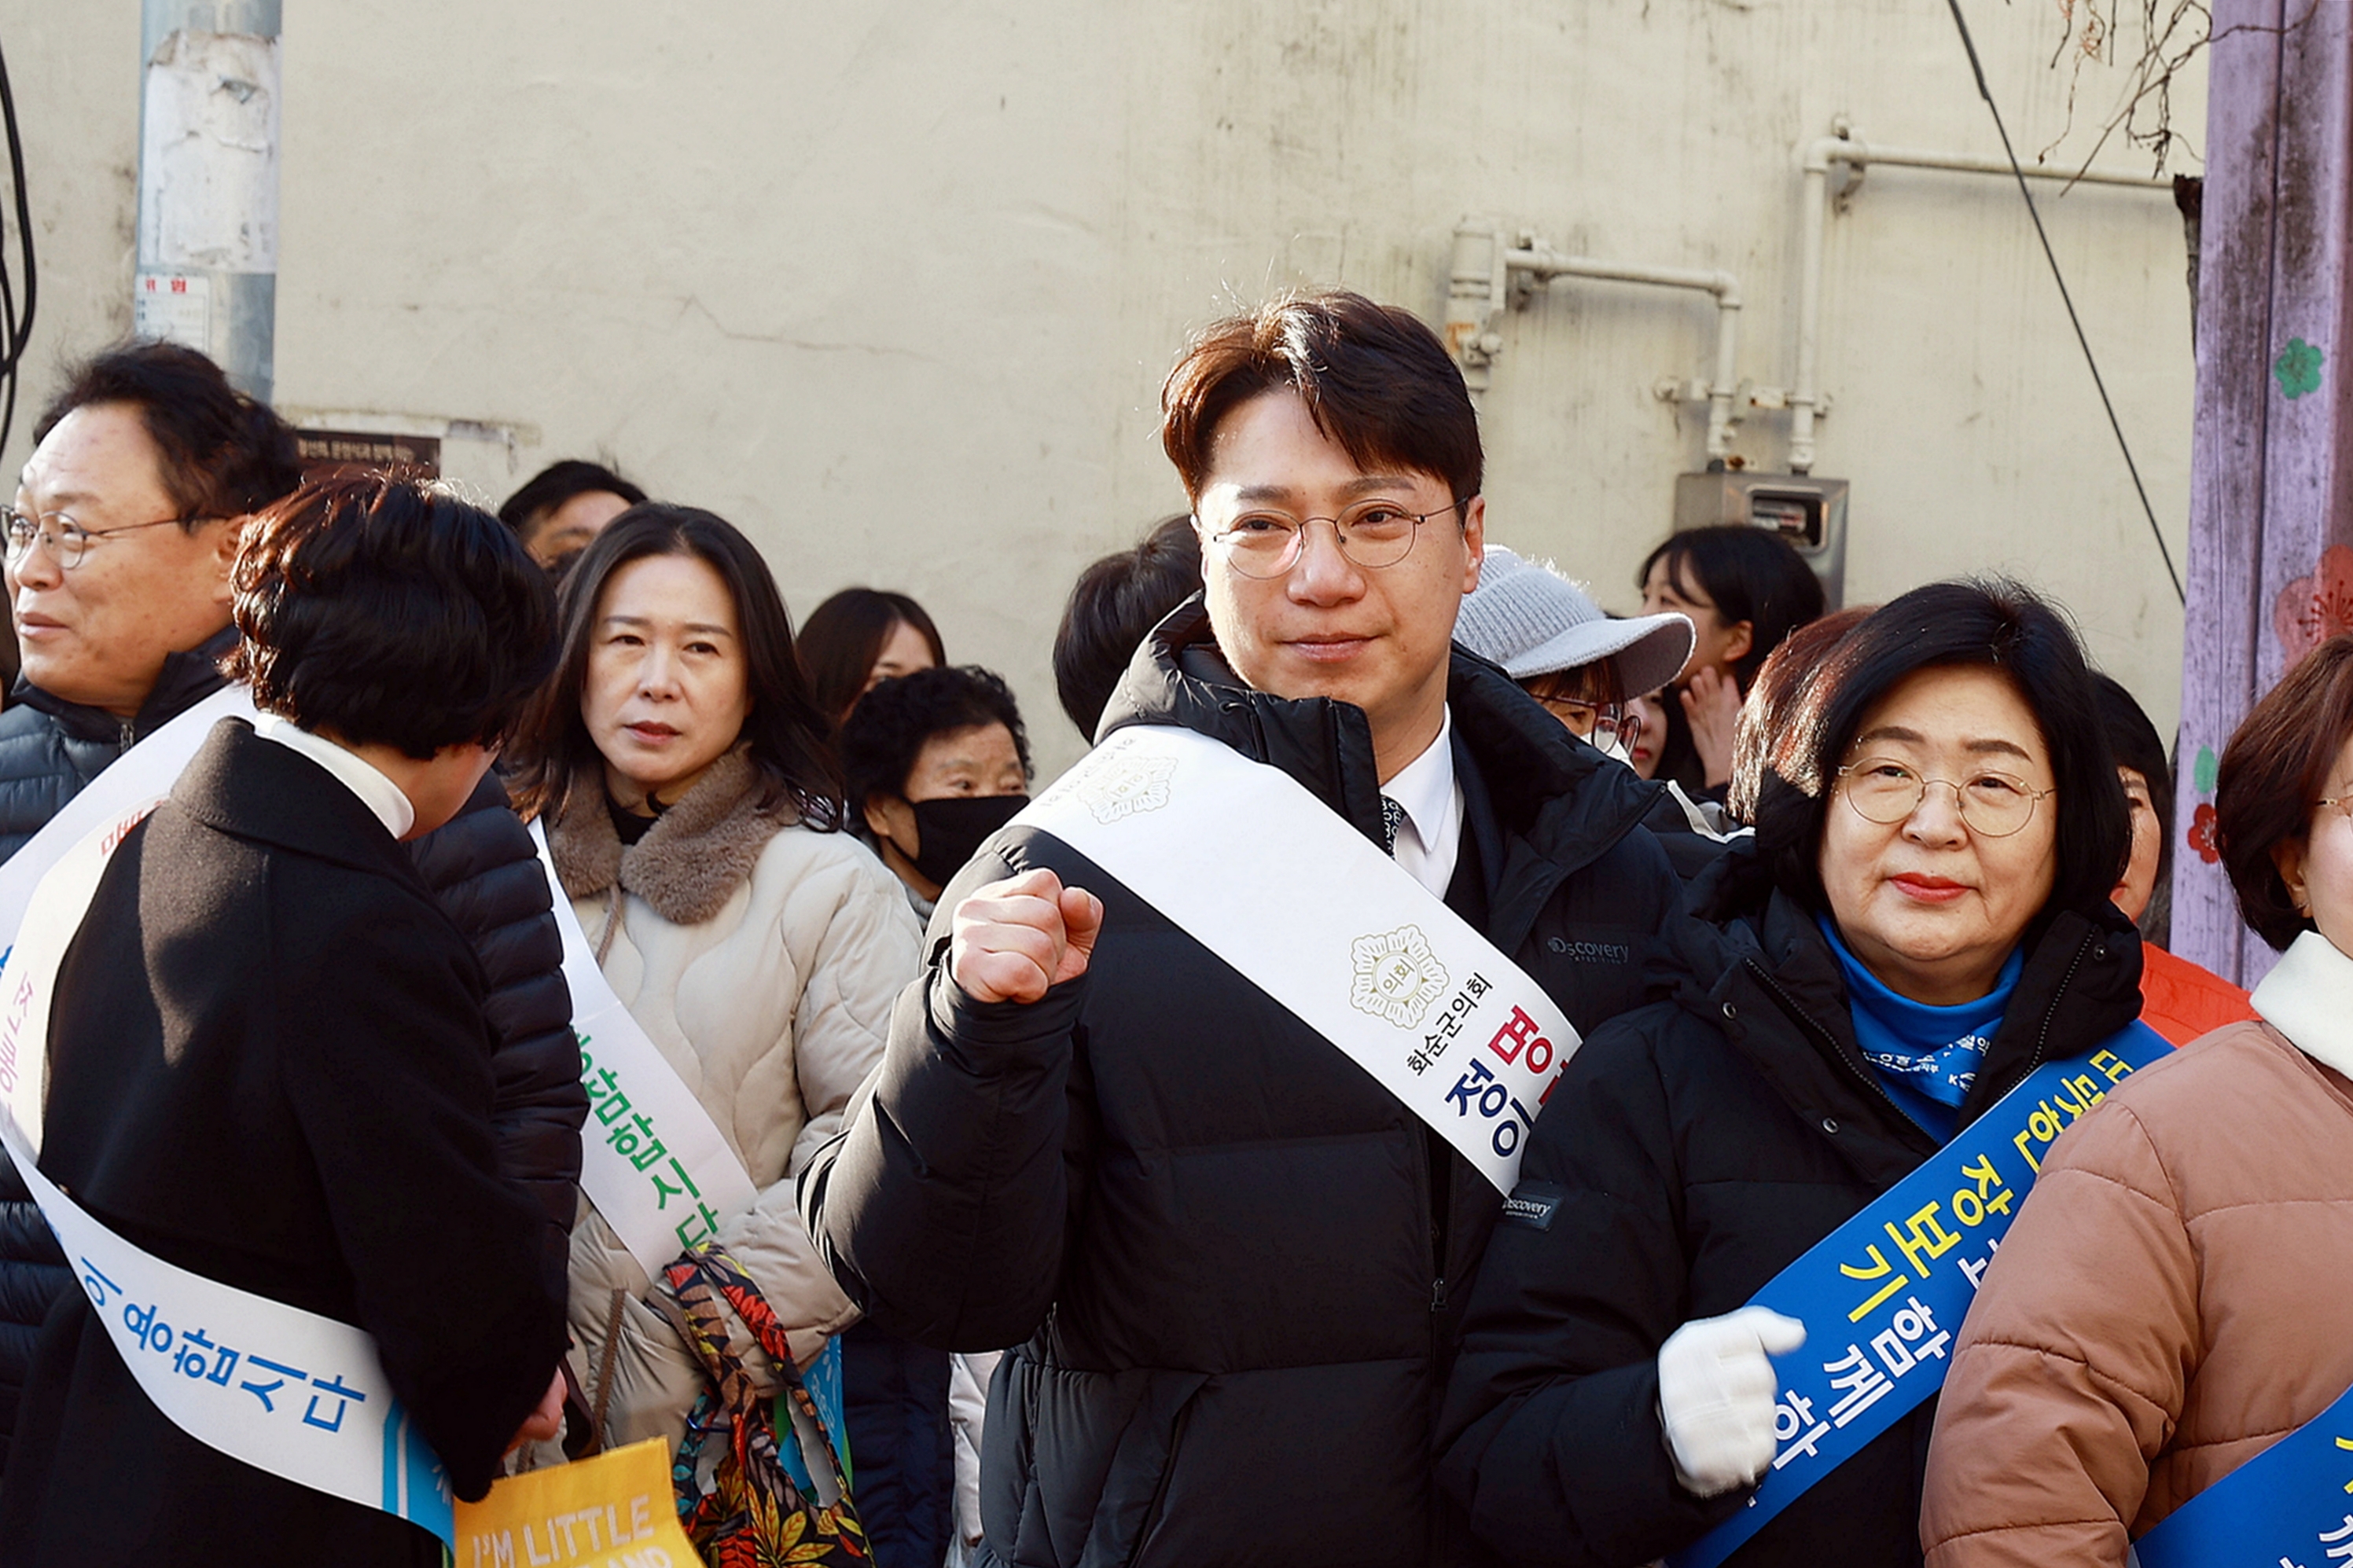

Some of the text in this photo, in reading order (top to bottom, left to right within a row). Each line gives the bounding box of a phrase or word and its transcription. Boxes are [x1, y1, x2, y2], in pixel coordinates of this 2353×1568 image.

[1382, 958, 1415, 994] 의회
[1406, 972, 1493, 1076] 화순군의회
[1840, 1154, 2015, 1324] 장보기
[81, 1256, 366, 1433] 이용합시다
[1747, 1295, 1952, 1507] 함께하
[522, 1494, 656, 1566] LITTLE
